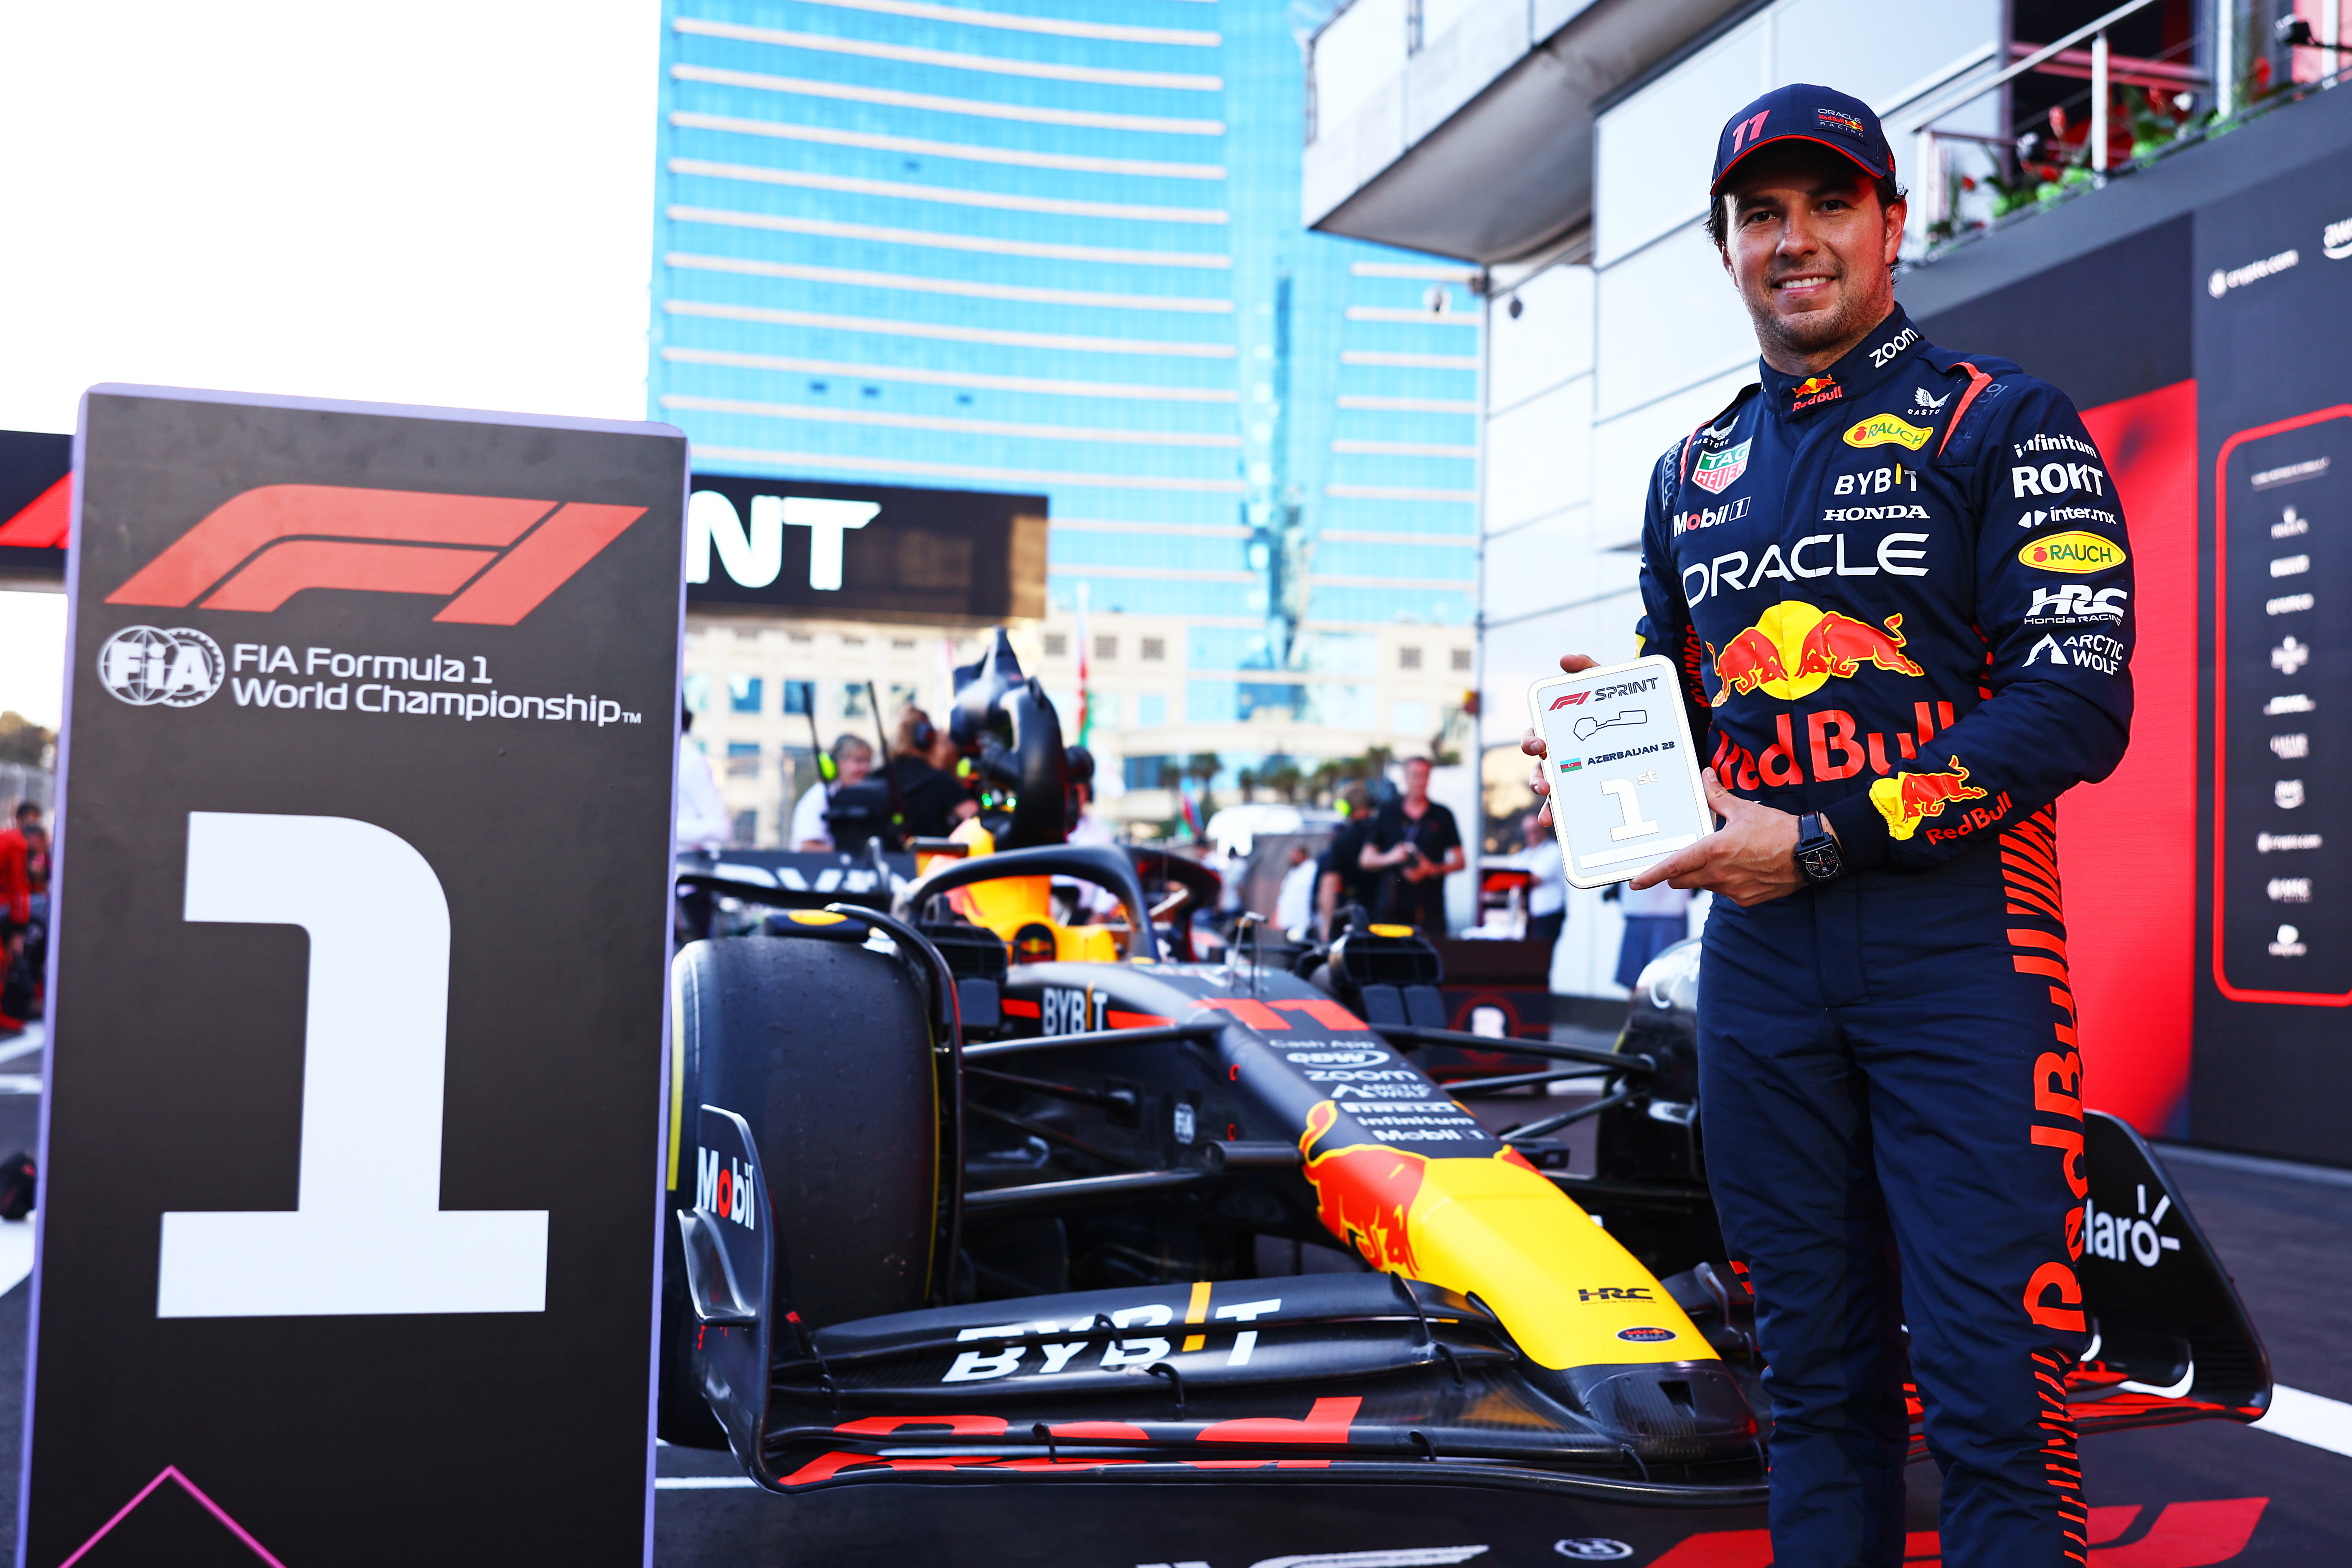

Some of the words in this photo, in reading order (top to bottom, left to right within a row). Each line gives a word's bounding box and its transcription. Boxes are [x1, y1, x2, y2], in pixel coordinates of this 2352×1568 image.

[1732, 109, 1770, 155] 11
[1817, 108, 1862, 124] ORACLE
[1820, 122, 1863, 137] RACING
[1869, 326, 1919, 368] zoom
[1792, 395, 1817, 411] Red
[1817, 386, 1843, 403] Bull
[1692, 438, 1729, 448] CASTORE
[1867, 421, 1924, 449] RAUCH
[2014, 434, 2097, 459] infinitum
[1705, 444, 1748, 469] TAG
[1696, 463, 1745, 490] HEUER
[1834, 463, 1917, 495] BYBIT
[2012, 462, 2103, 498] ROKT
[1673, 504, 1730, 537] Mobil
[1823, 505, 1931, 522] HONDA
[2049, 506, 2118, 525] inter.mx
[104, 484, 649, 626] F1
[2050, 544, 2113, 563] RAUCH
[1682, 532, 1930, 609] ORACLE
[2025, 584, 2128, 619] HRC
[2024, 616, 2076, 625] Honda
[2078, 614, 2121, 627] RACING
[2063, 634, 2124, 660] ARCTIC
[2072, 649, 2119, 676] WOLF
[233, 643, 299, 675] FIA
[306, 647, 465, 684] Formula
[471, 656, 493, 685] 1
[231, 677, 349, 710] World
[355, 683, 621, 728] Championship
[1548, 690, 1592, 711] F1
[1594, 677, 1659, 702] SPRINT
[1588, 744, 1659, 766] AZERBAIJAN
[1712, 713, 1803, 792] Red
[1926, 814, 1974, 846] Red
[1970, 791, 2013, 831] Bull
[1042, 981, 1108, 1036] BYBIT
[1188, 998, 1370, 1031] 11
[156, 811, 549, 1318] 1
[1372, 1129, 1462, 1141] Mobil
[696, 1146, 755, 1231] Mobil
[2081, 1197, 2161, 1268] laro
[1578, 1287, 1653, 1302] HRC
[941, 1281, 1282, 1383] BYBIT
